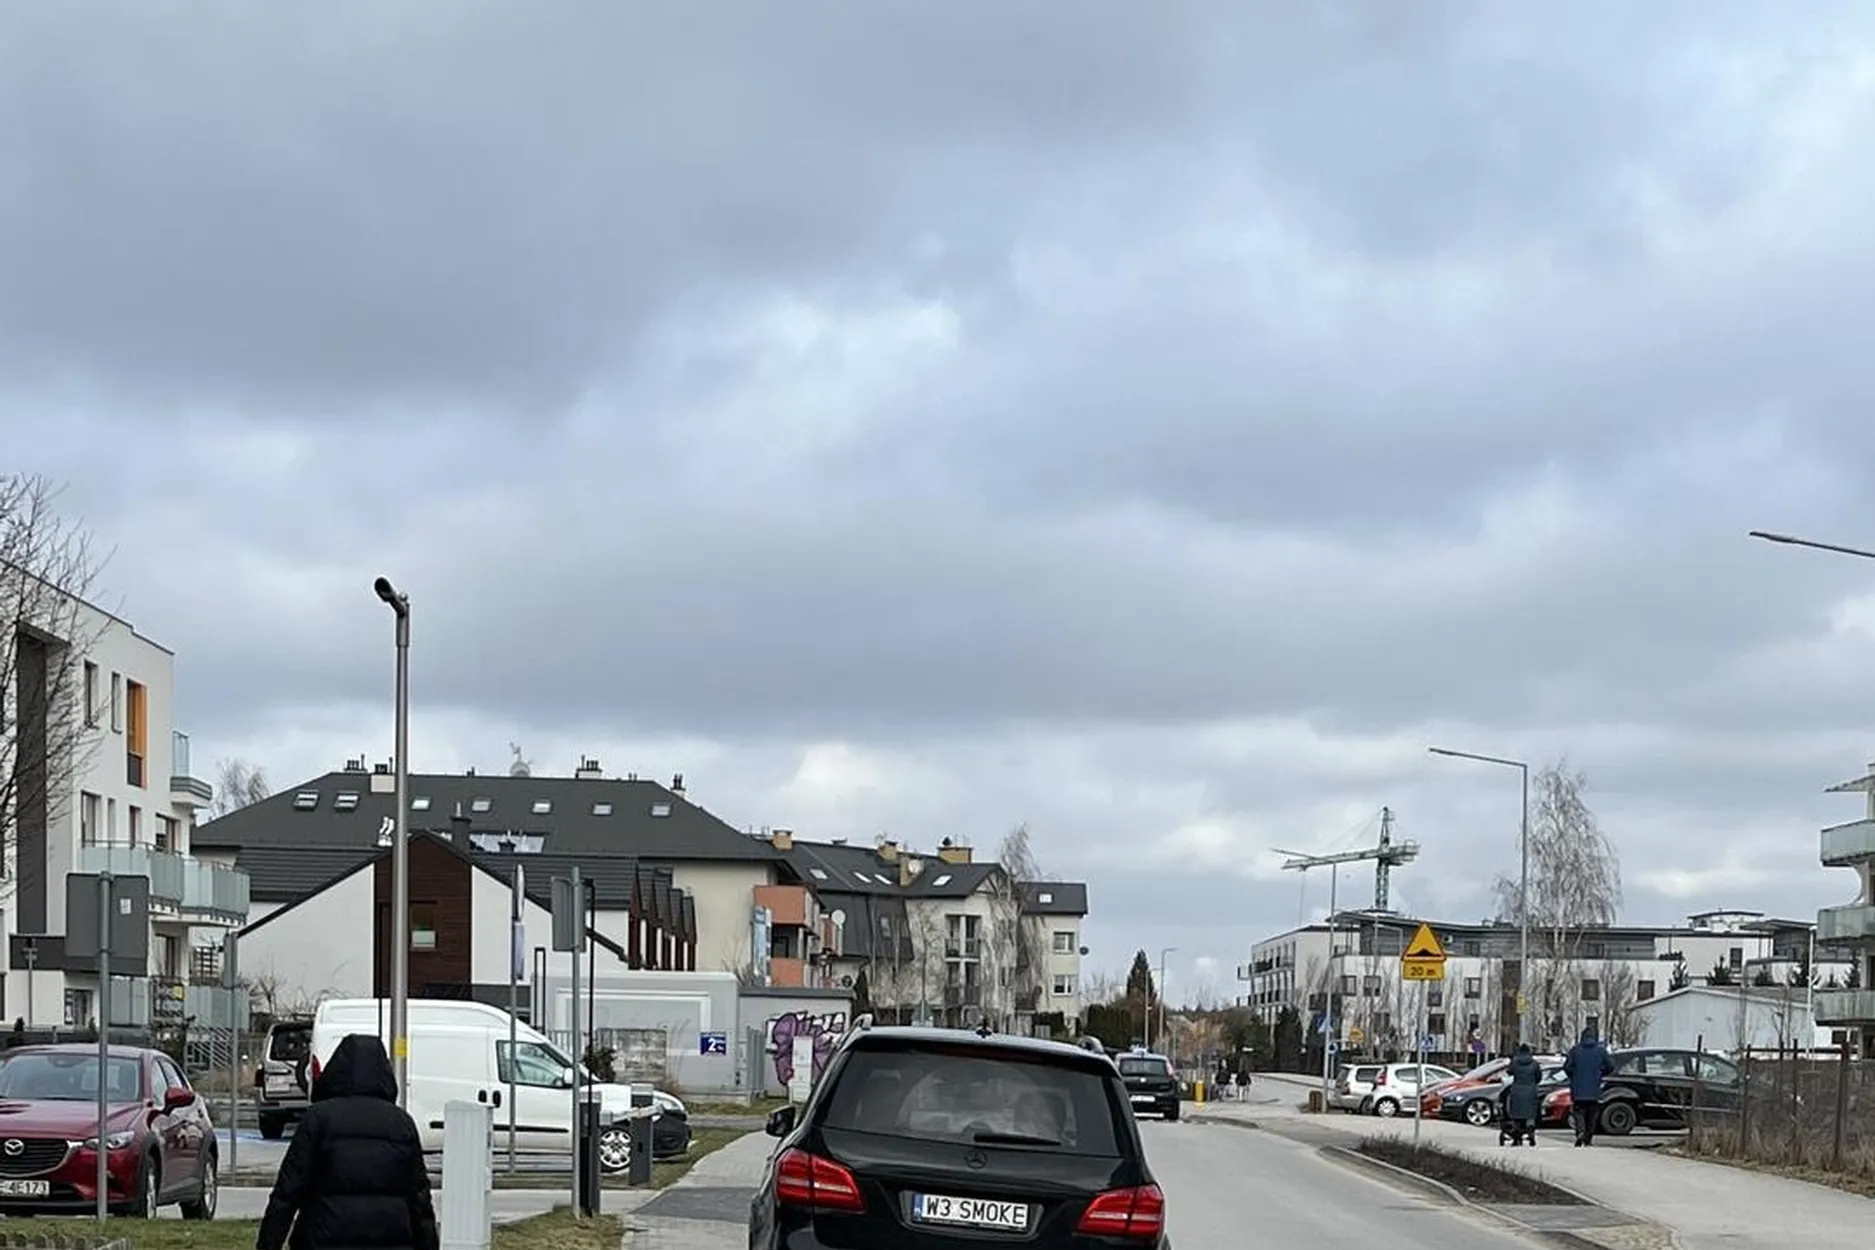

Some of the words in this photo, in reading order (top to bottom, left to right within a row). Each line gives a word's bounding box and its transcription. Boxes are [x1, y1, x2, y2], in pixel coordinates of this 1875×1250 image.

[1411, 966, 1424, 976] 20
[1426, 968, 1437, 976] m
[708, 1037, 716, 1052] 2
[927, 1197, 951, 1217] W3
[960, 1201, 1025, 1225] SMOKE
